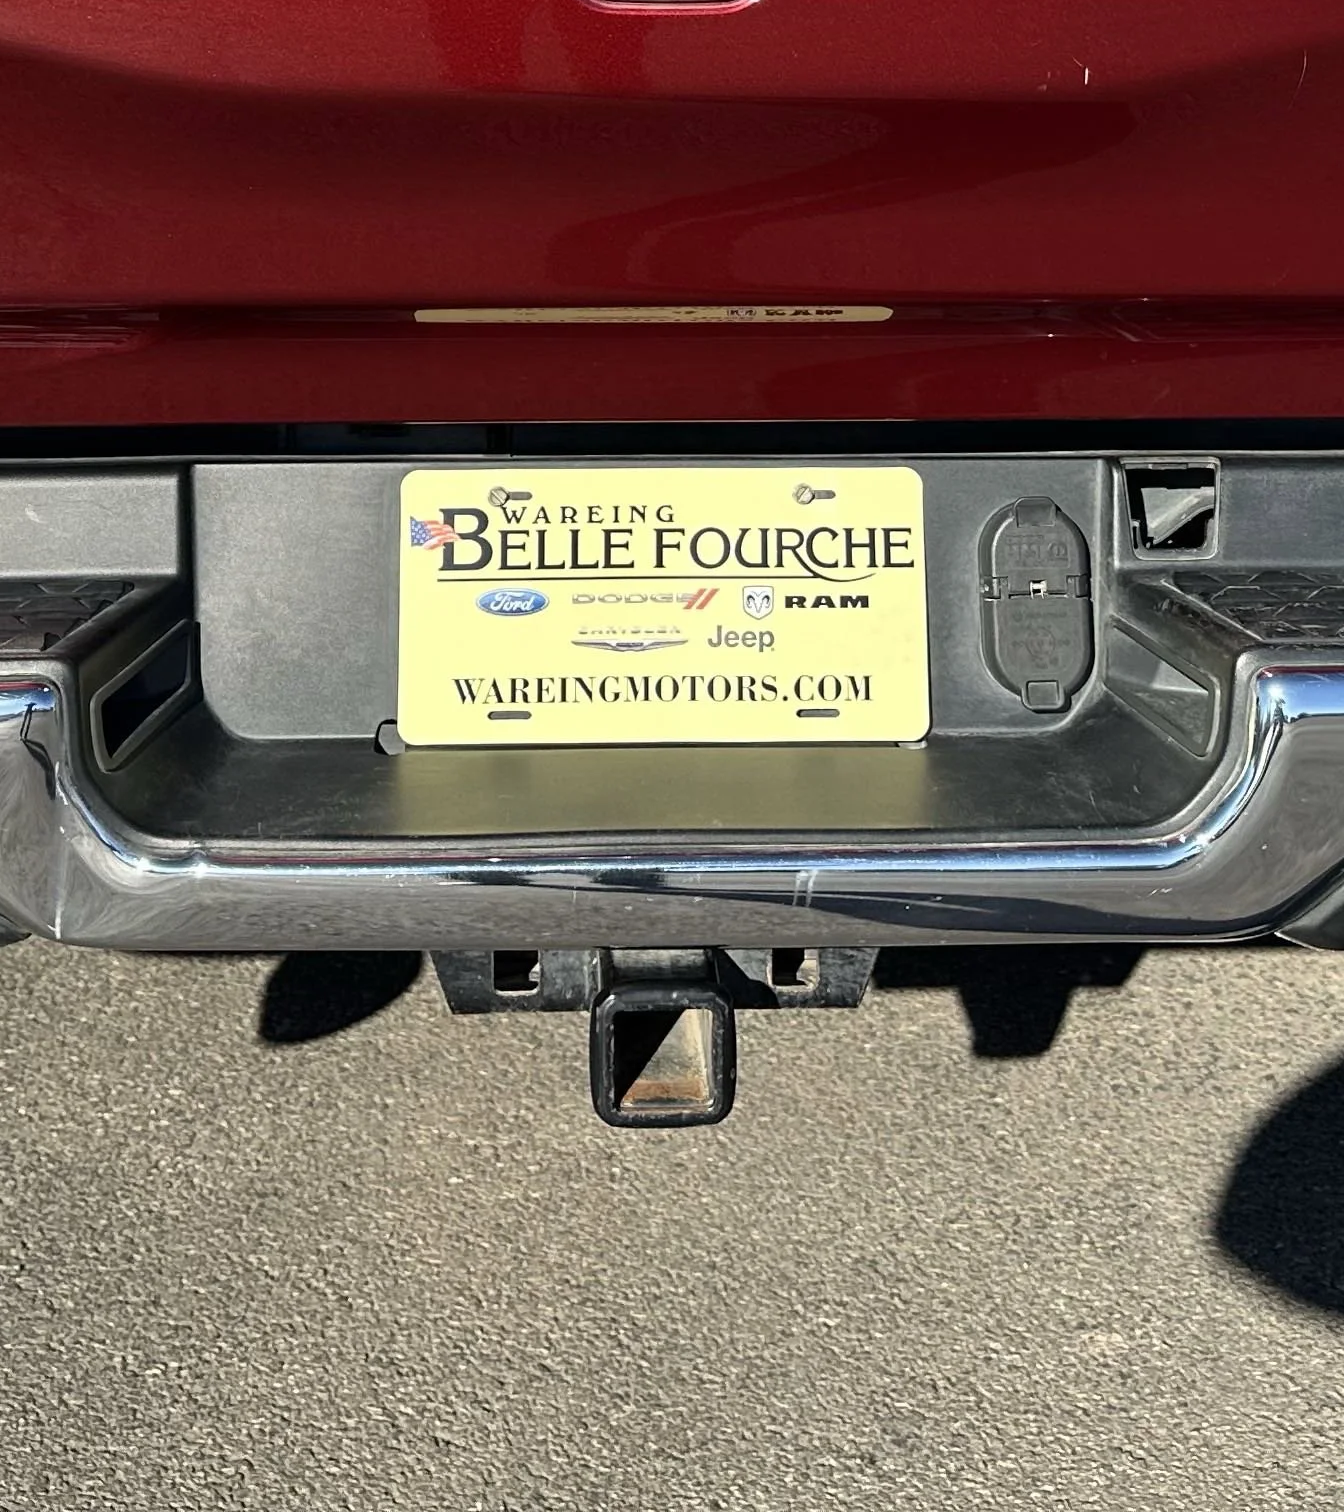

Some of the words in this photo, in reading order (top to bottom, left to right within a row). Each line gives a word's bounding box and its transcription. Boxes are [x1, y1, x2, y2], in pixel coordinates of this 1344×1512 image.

[501, 504, 676, 525] WAREING
[438, 506, 636, 572] BELLE
[653, 526, 915, 581] FOURCHE
[571, 592, 698, 605] DODGE
[785, 594, 870, 609] RAM
[707, 624, 775, 653] Jeep
[452, 674, 874, 705] WAREINGMOTORS.COM
